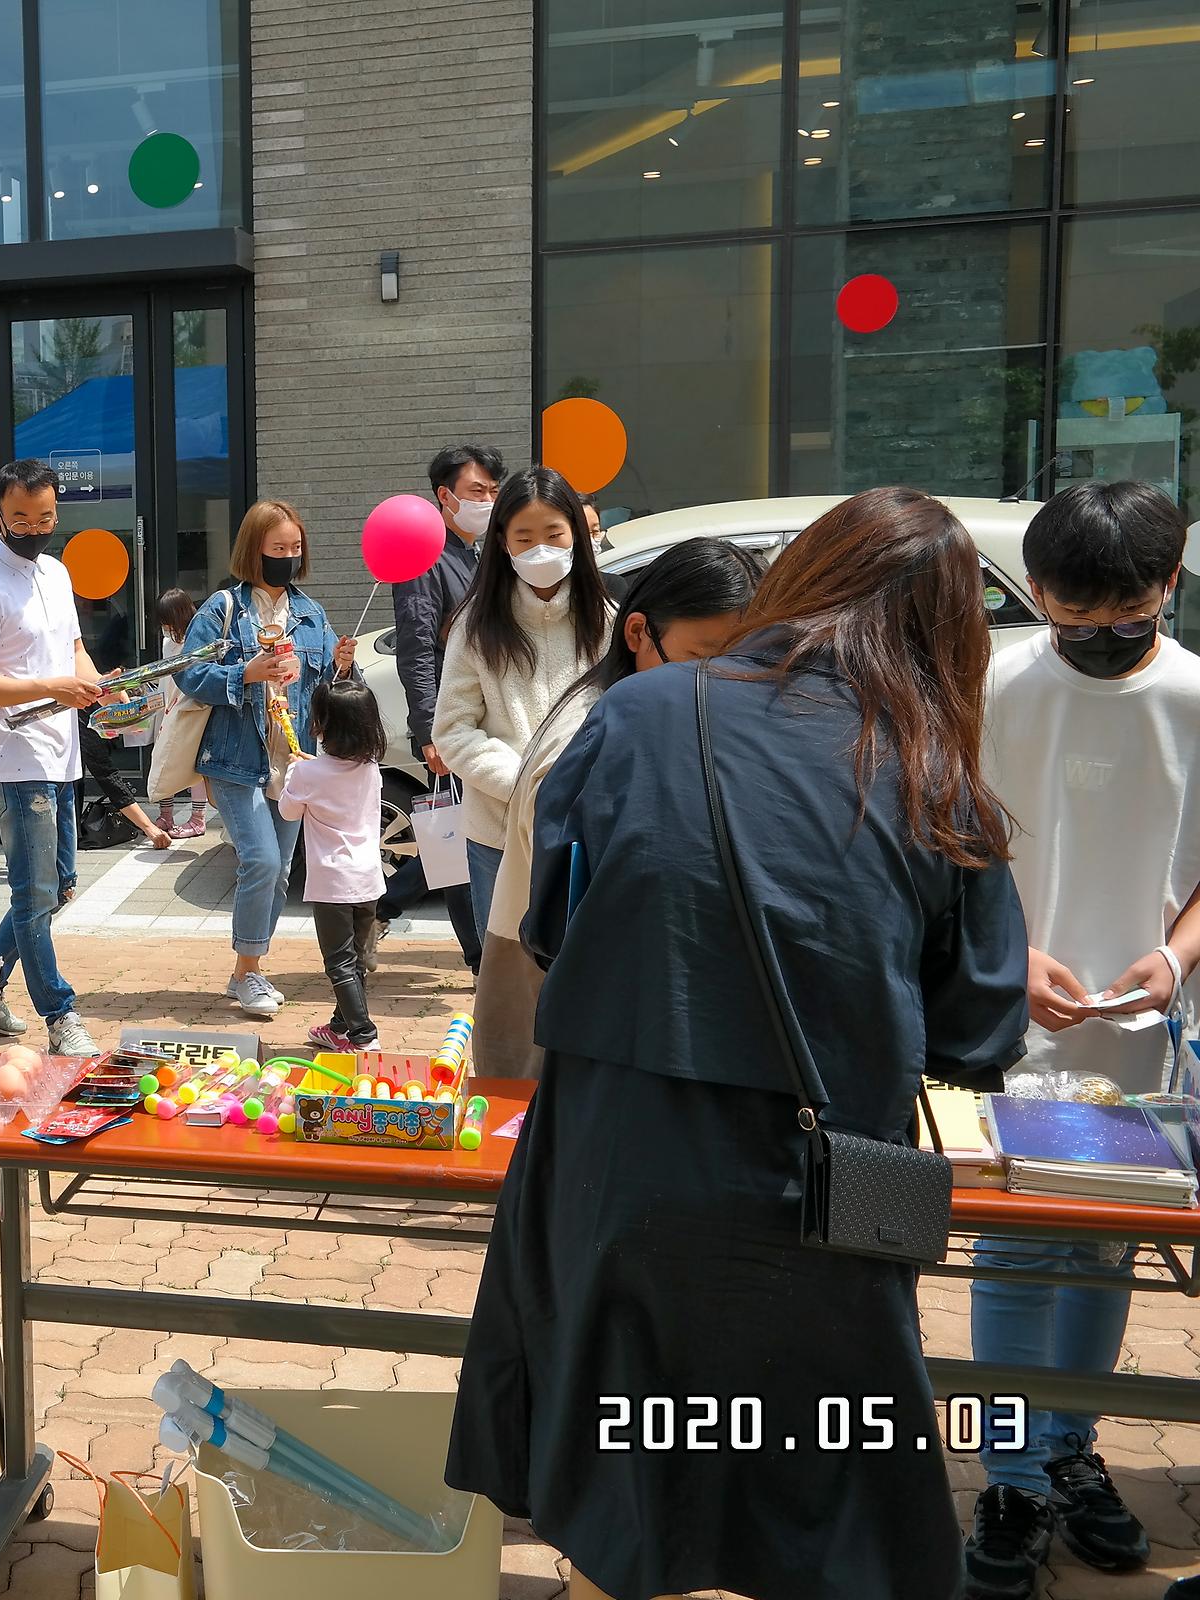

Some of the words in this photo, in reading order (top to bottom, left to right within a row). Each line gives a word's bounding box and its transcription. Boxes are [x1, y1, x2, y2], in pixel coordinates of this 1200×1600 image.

[58, 461, 79, 470] 오른쪽
[58, 472, 79, 481] 출입문
[80, 471, 93, 480] 이용
[372, 1110, 421, 1136] 종이총
